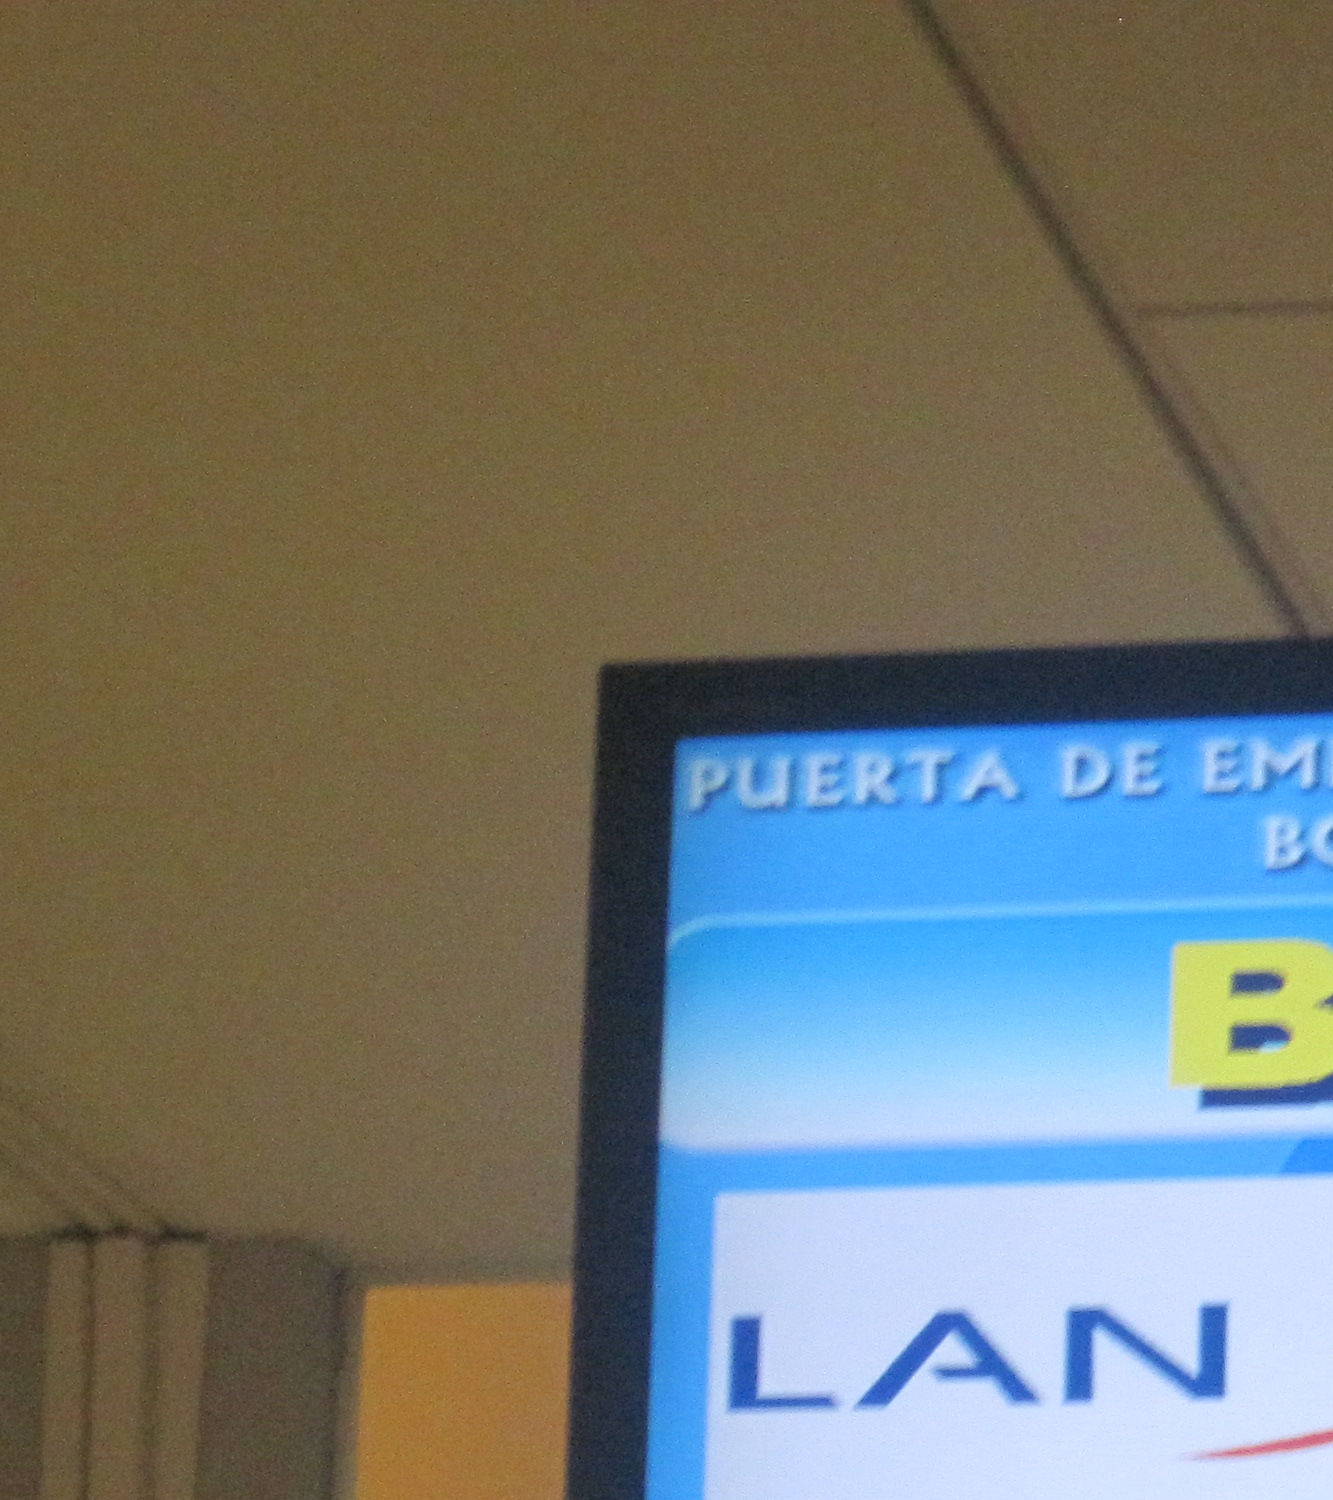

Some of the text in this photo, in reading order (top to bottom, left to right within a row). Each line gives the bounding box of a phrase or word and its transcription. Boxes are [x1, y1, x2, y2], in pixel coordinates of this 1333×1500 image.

[685, 747, 1020, 812] PUERTA
[1060, 740, 1164, 801] DE
[727, 1300, 1229, 1413] LAN
